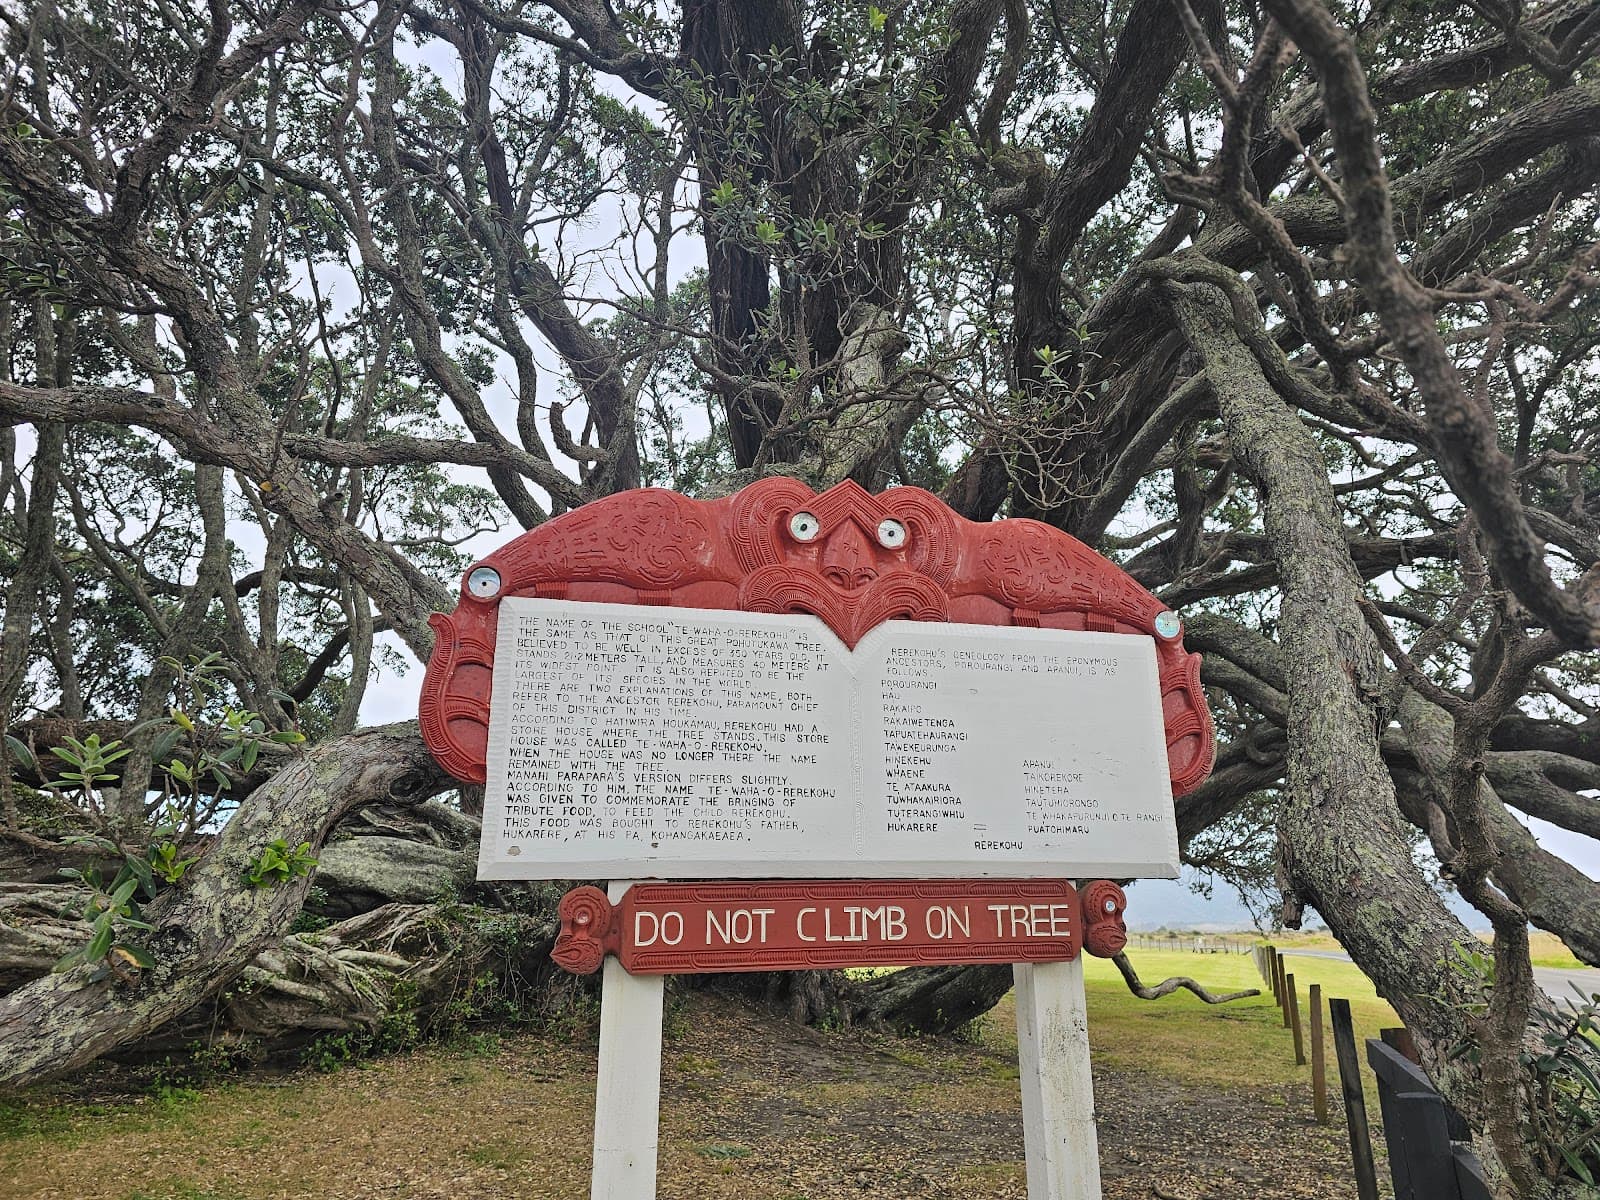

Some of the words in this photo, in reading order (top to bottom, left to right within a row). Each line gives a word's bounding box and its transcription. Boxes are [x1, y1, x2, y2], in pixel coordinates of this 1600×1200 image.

[519, 616, 540, 626] THE
[546, 618, 575, 629] NAME
[601, 621, 622, 631] THE
[519, 628, 540, 637] THE
[546, 629, 576, 639] SAME
[583, 631, 597, 640] AS
[605, 633, 632, 641] THAT
[659, 634, 682, 644] THIS
[688, 636, 718, 646] GREAT
[726, 638, 789, 650] POHUTUKAWA
[517, 638, 567, 649] BELIEVED
[615, 644, 642, 653] WELL
[752, 650, 783, 660] YEARS
[516, 649, 557, 659] STANDS
[666, 657, 687, 666] AND
[693, 657, 745, 668] MEASURES
[753, 661, 766, 669] 40
[771, 661, 809, 671] METERS
[816, 663, 829, 671] AT
[515, 660, 532, 669] ITS
[669, 667, 695, 675] ALSO
[786, 671, 805, 681] THE
[514, 671, 564, 680] LARGEST
[595, 674, 612, 683] ITS
[692, 679, 711, 687] THE
[515, 682, 550, 691] THERE
[560, 683, 580, 692] ARE
[589, 684, 611, 693] TWO
[721, 689, 742, 698] THIS
[787, 692, 812, 701] BOTH
[512, 692, 548, 702] REFER
[556, 693, 570, 703] TO
[579, 694, 598, 704] THE
[605, 695, 660, 705] ANCESTOR
[727, 700, 784, 710] PARAMOUNT
[790, 702, 819, 712] CHIEF
[535, 704, 558, 713] THIS
[568, 705, 616, 714] DISTRICT
[626, 706, 637, 715] IN
[644, 708, 661, 716] HIS
[511, 714, 575, 725] ACCORDING
[583, 716, 598, 725] TO
[724, 721, 777, 731] REREKOHU
[784, 723, 804, 732] HAD
[510, 736, 548, 746] HOUSE
[554, 738, 577, 747] WAS
[586, 738, 627, 749] CALLED
[511, 726, 547, 735] STORE
[556, 727, 593, 736] HOUSE
[602, 729, 638, 738] WHERE
[649, 730, 668, 739] THE
[677, 731, 705, 740] TREE
[763, 733, 786, 743] THIS
[796, 734, 829, 744] STORE
[509, 748, 540, 758] WHEN
[550, 749, 571, 759] THE
[579, 749, 614, 759] HOUSE
[621, 750, 643, 760] WAS
[651, 751, 666, 760] NO
[675, 752, 714, 761] LONGER
[722, 753, 755, 763] THERE
[762, 754, 781, 763] THE
[791, 755, 817, 764] NAME
[508, 759, 561, 769] REMAINED
[571, 761, 596, 770] WITH
[606, 761, 625, 771] THE
[507, 771, 548, 781] MANAHI
[633, 773, 681, 783] VERSION
[689, 774, 732, 784] DIFFERS
[506, 782, 574, 792] ACCORDING
[582, 783, 598, 792] TO
[635, 784, 656, 794] THE
[665, 786, 694, 795] NAME
[886, 782, 899, 792] TE
[507, 794, 530, 803] WAS
[539, 795, 573, 804] GIVEN
[581, 795, 598, 804] TO
[606, 795, 689, 806] COMMEMORATE
[699, 796, 719, 806] THE
[728, 798, 775, 807] BRINGING
[782, 799, 796, 807] OF
[504, 806, 554, 816] TRIBUTE
[603, 807, 616, 816] TO
[625, 807, 654, 817] FEED
[663, 808, 685, 817] THE
[693, 808, 723, 817] CHILD
[504, 817, 530, 827] THIS
[540, 818, 570, 828] FOOD
[579, 819, 602, 827] WAS
[665, 820, 679, 829] TO
[574, 830, 588, 839] AT
[598, 830, 615, 839] HIS
[634, 910, 684, 947] DO
[705, 908, 776, 945] NOT
[796, 905, 908, 942] CLIMB
[925, 904, 971, 939] ON
[987, 903, 1071, 938] TREE
